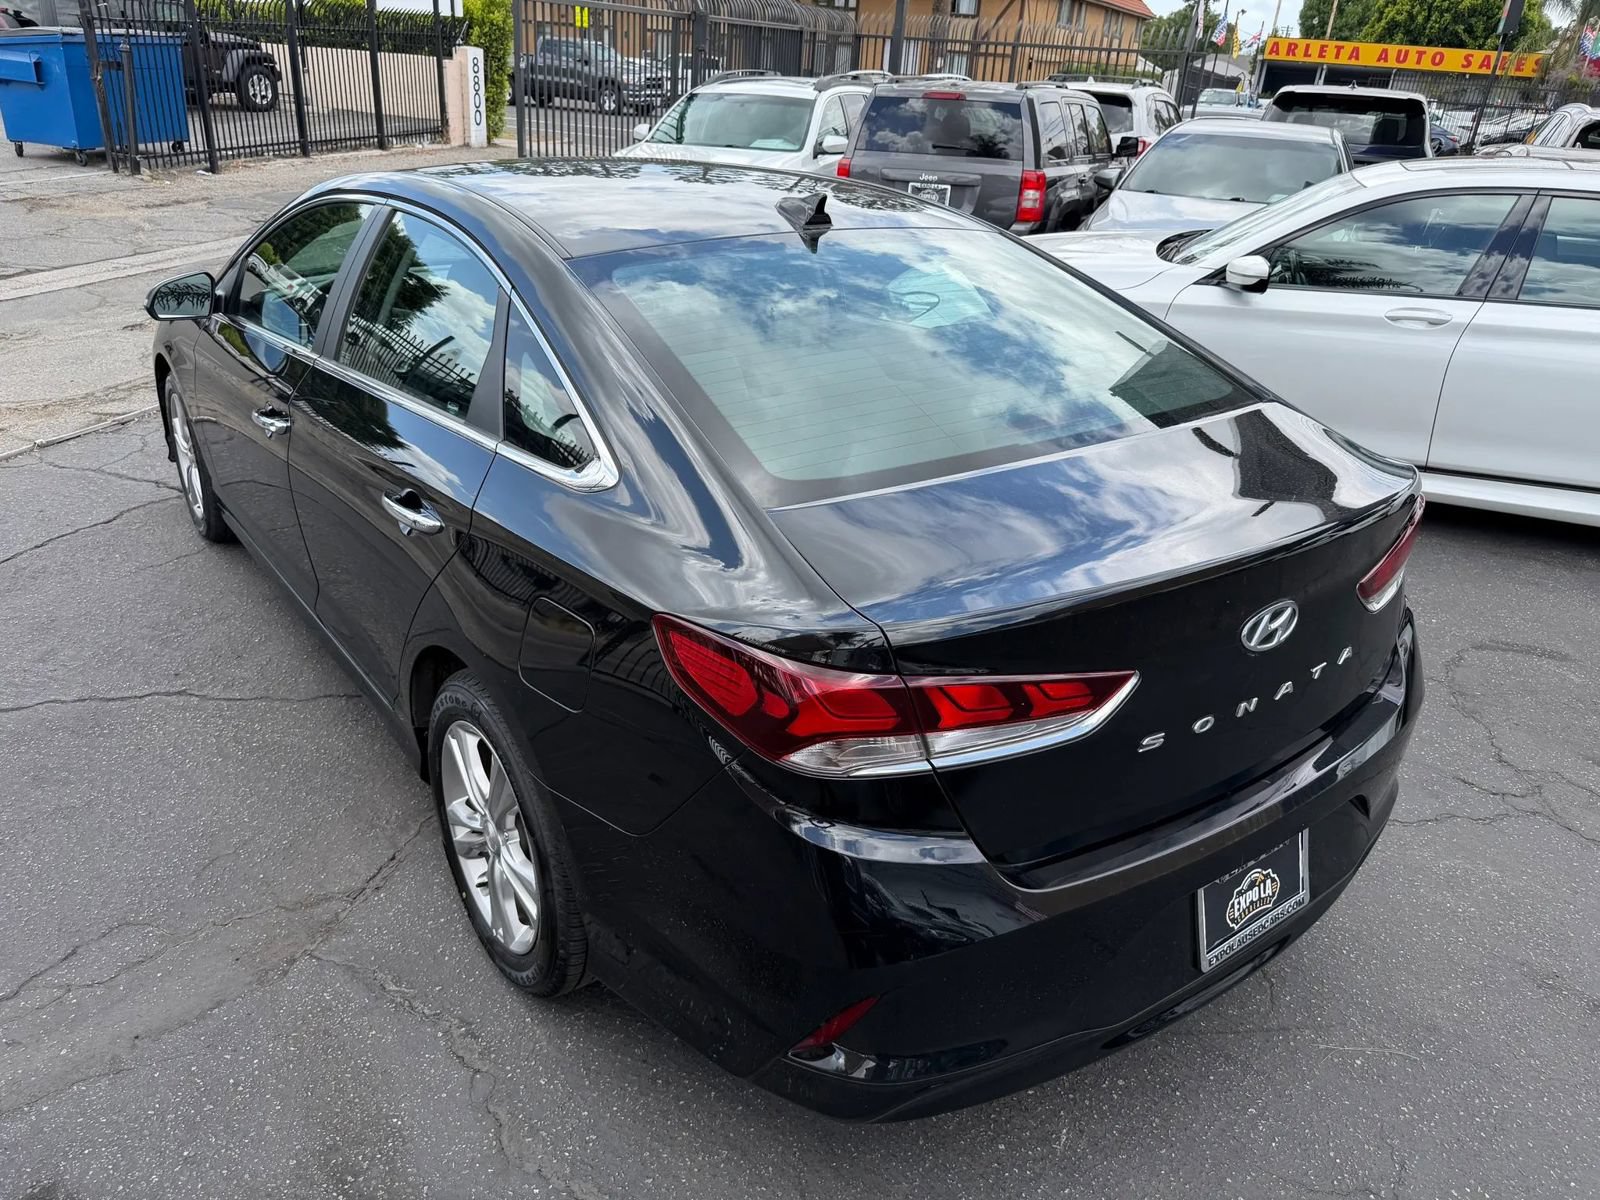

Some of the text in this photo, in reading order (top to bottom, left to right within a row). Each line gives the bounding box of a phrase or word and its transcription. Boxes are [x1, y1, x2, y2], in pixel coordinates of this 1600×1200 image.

[1268, 40, 1360, 61] ARLETA
[1376, 47, 1445, 67] AUTO
[472, 56, 482, 126] 8800
[919, 172, 938, 182] Jeep
[1137, 646, 1353, 753] SONATA
[1234, 879, 1273, 919] EXPO LA
[1208, 896, 1305, 968] EXPOLAUSEDCARS.COM
